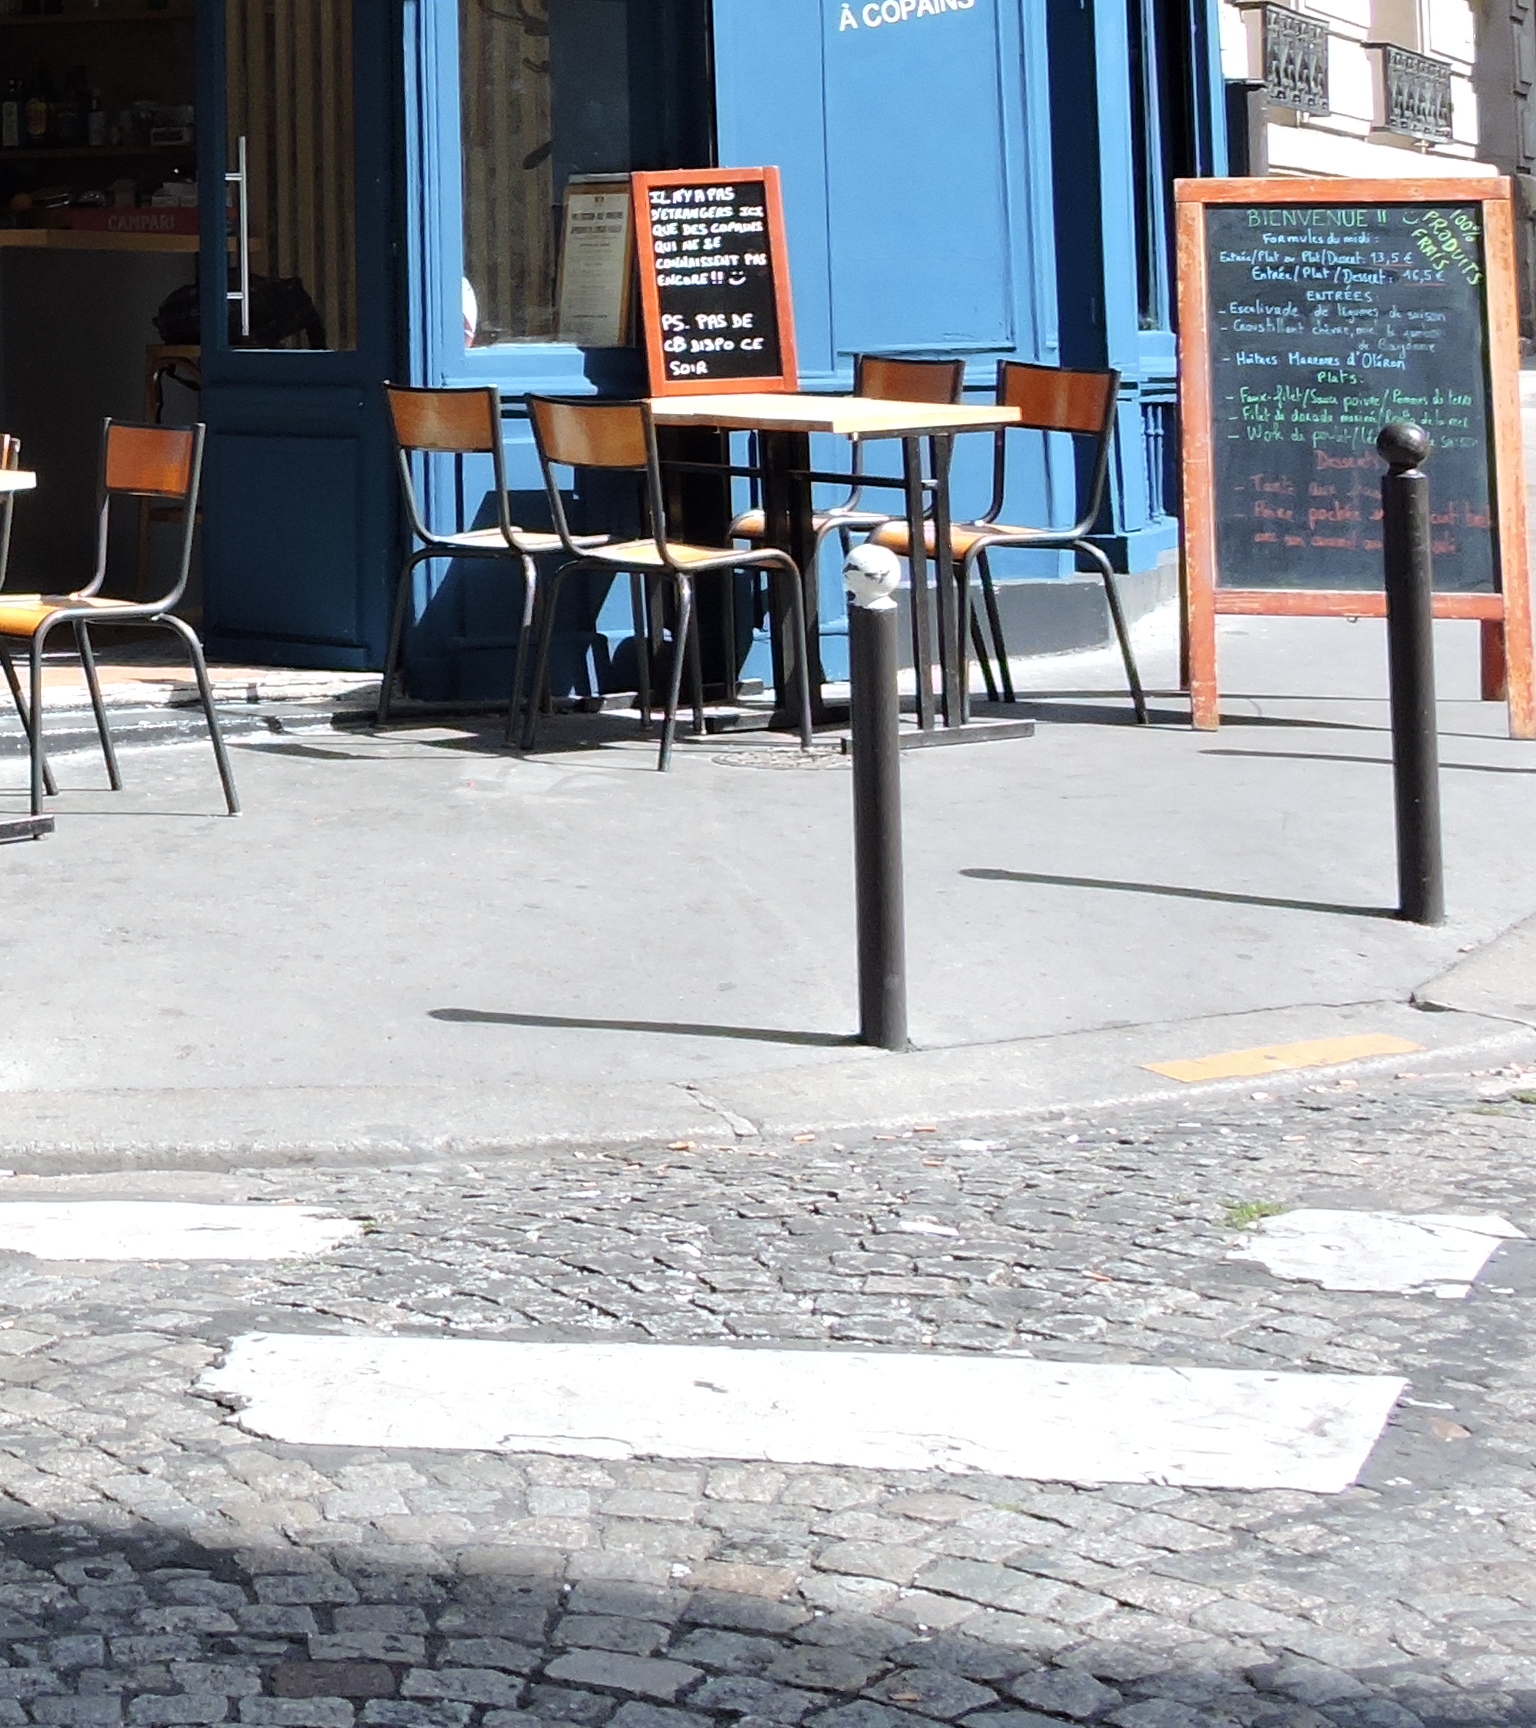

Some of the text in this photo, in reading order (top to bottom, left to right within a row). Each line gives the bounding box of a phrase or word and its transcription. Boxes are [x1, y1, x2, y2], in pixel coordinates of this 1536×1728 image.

[839, 3, 858, 31] À
[649, 190, 671, 204] IL
[707, 187, 735, 201] PAS
[108, 215, 175, 231] CAMPARI
[1247, 208, 1368, 227] BIENVENUE
[652, 221, 763, 237] QUE DES COPAINS
[654, 236, 722, 253] QUI NE SE
[1411, 228, 1450, 270] FRAIS
[1422, 210, 1483, 285] PRODUITS
[744, 253, 767, 265] PAS
[695, 313, 728, 330] PAS
[731, 313, 754, 328] DE
[664, 336, 687, 352] CB
[740, 337, 765, 350] CE
[669, 360, 708, 375] SOIR
